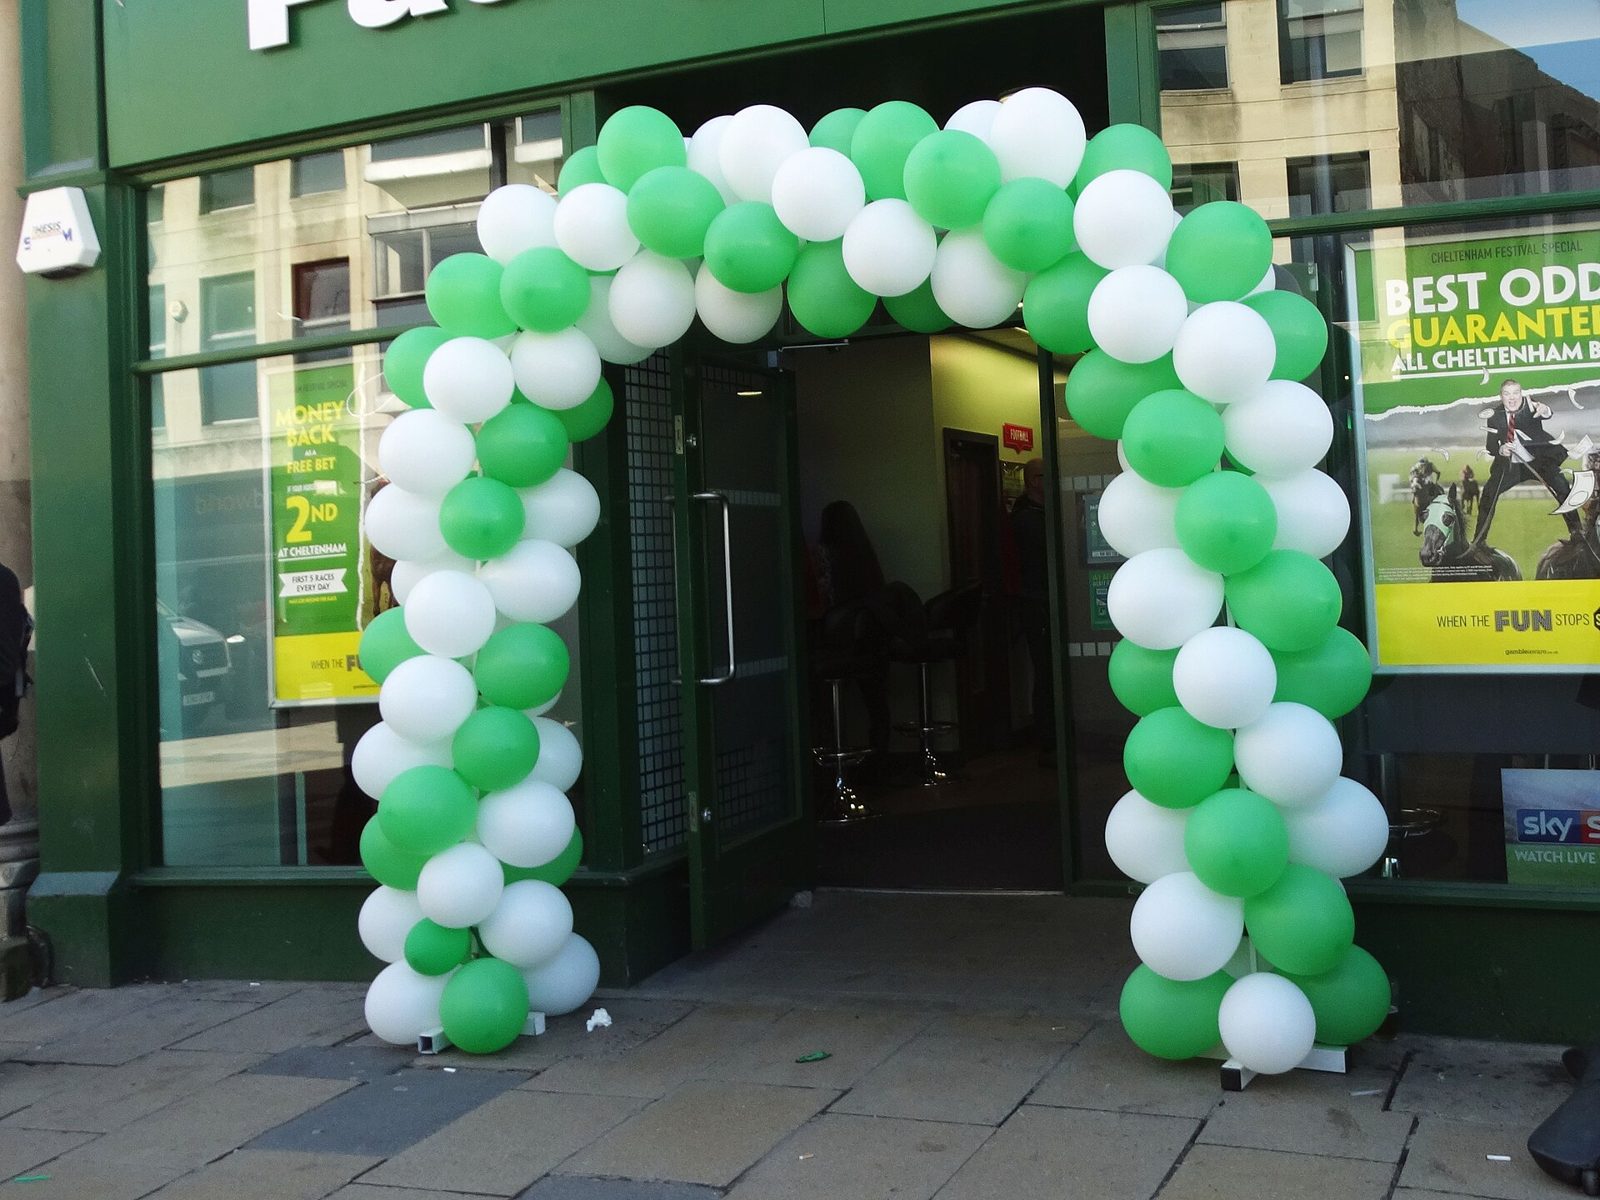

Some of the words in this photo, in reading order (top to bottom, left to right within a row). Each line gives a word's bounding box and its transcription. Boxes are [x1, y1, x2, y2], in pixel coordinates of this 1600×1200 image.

[1431, 249, 1493, 264] CHELTENHAM
[1495, 244, 1539, 258] FESTIVAL
[1541, 240, 1583, 254] SPECIAL
[1385, 272, 1487, 316] BEST
[1391, 352, 1428, 372] ALL
[1432, 341, 1583, 369] CHELTENHAM
[276, 400, 345, 427] MONEY
[287, 424, 336, 447] BACK
[287, 459, 313, 474] FREE
[315, 456, 337, 471] BET
[286, 495, 338, 543] 2ND
[277, 547, 289, 559] AT
[289, 542, 347, 557] CHELTENHAM
[292, 575, 308, 584] FIRST
[310, 574, 314, 582] 5
[315, 573, 335, 582] RACES
[296, 584, 316, 592] EVERY
[318, 583, 330, 591] DAY
[1437, 615, 1467, 628] WHEN
[1471, 615, 1490, 627] THE
[1494, 609, 1553, 632] FUN
[1555, 613, 1590, 626] STOPS
[311, 659, 330, 669] WHEN
[332, 659, 344, 668] THE
[1523, 810, 1573, 842] sky
[1515, 850, 1563, 863] WATCH
[1567, 851, 1596, 864] LIVE
